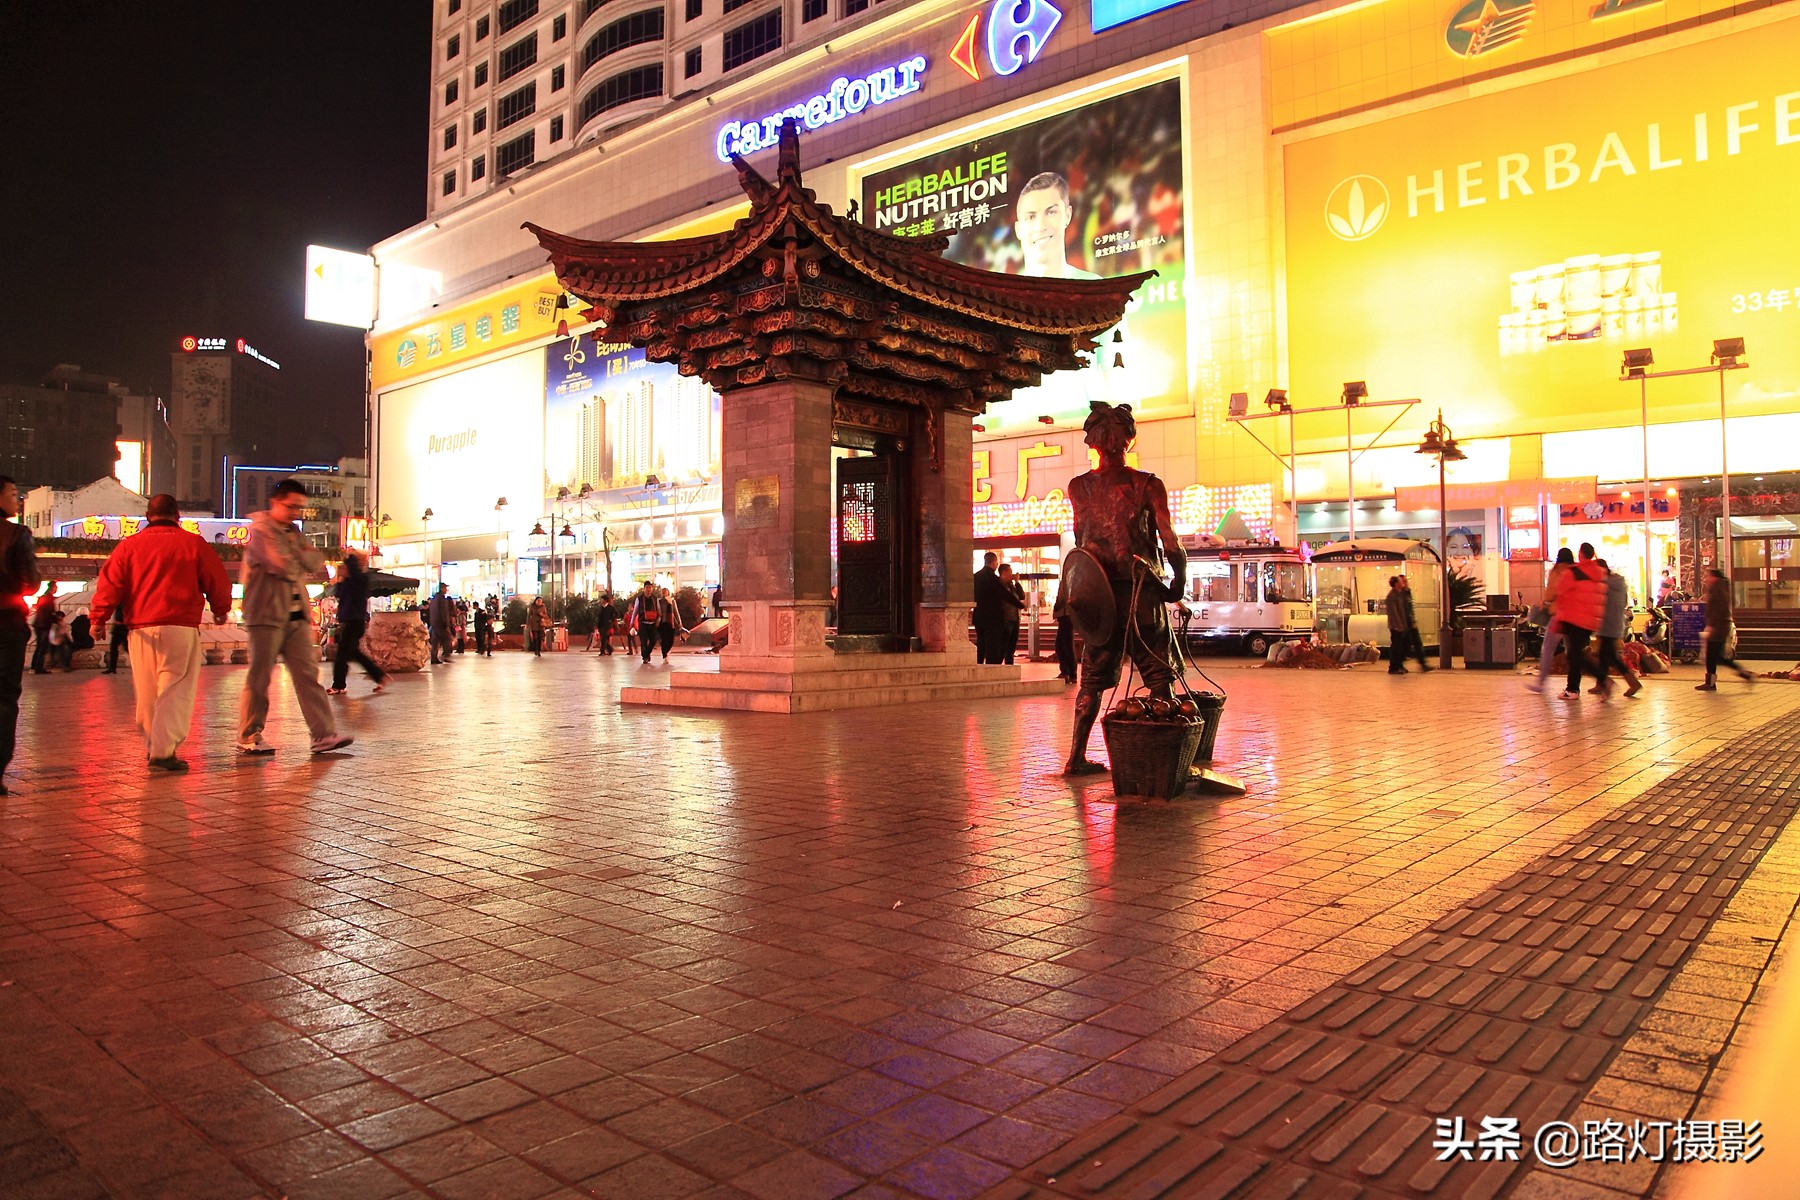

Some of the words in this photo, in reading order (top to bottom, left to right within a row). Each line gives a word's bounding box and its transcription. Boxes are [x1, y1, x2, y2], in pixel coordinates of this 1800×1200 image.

[1406, 89, 1800, 219] HERBALIFE
[875, 151, 1008, 209] HERBALIFE
[875, 173, 1008, 229] NUTRITION
[537, 307, 551, 316] BUY
[538, 296, 555, 307] BEST
[1731, 285, 1800, 315] 33年
[426, 303, 520, 360] 五星电器
[428, 427, 477, 455] Purapple
